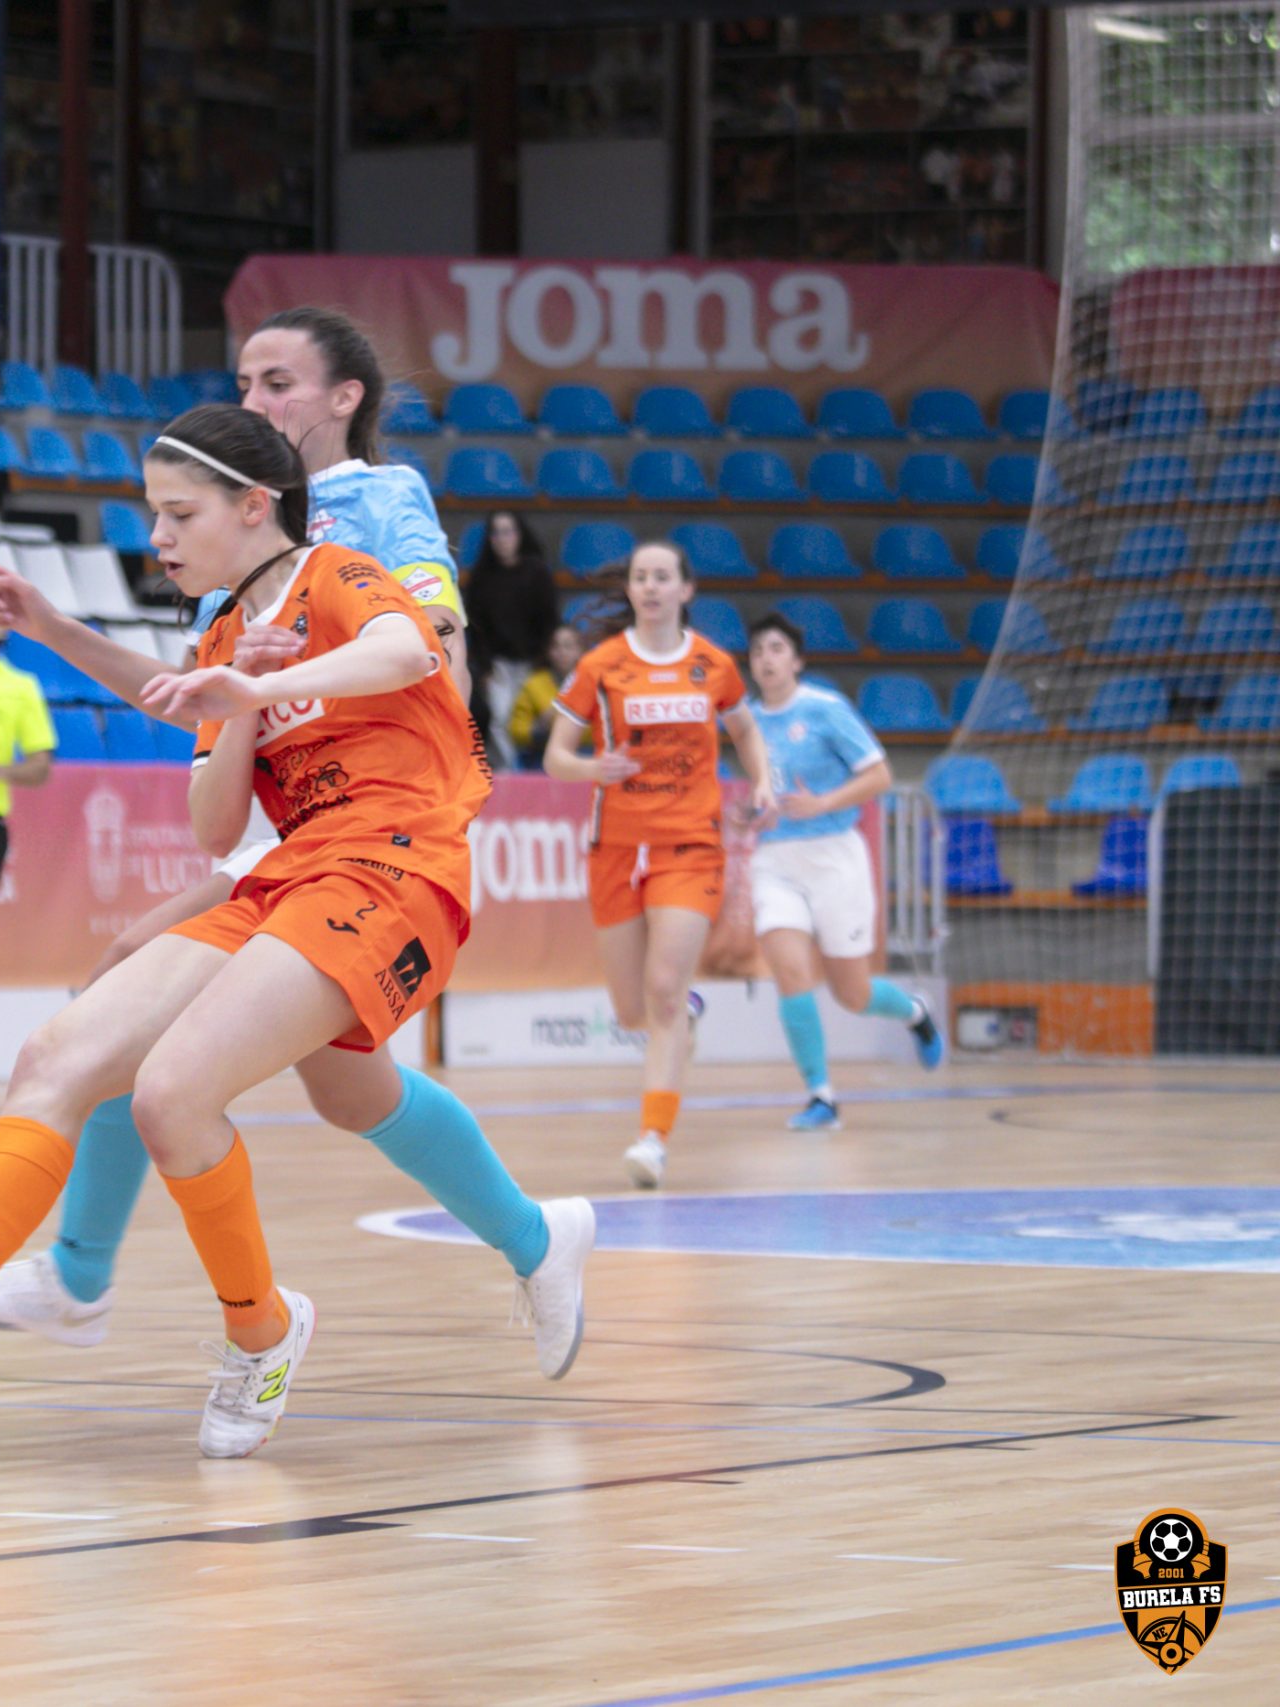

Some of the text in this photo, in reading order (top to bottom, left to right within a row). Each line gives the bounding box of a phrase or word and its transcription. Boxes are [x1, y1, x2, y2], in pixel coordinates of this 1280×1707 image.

[430, 264, 869, 383] Joma
[628, 701, 706, 721] REYCO
[355, 900, 378, 921] 2
[374, 968, 406, 1022] ABSA
